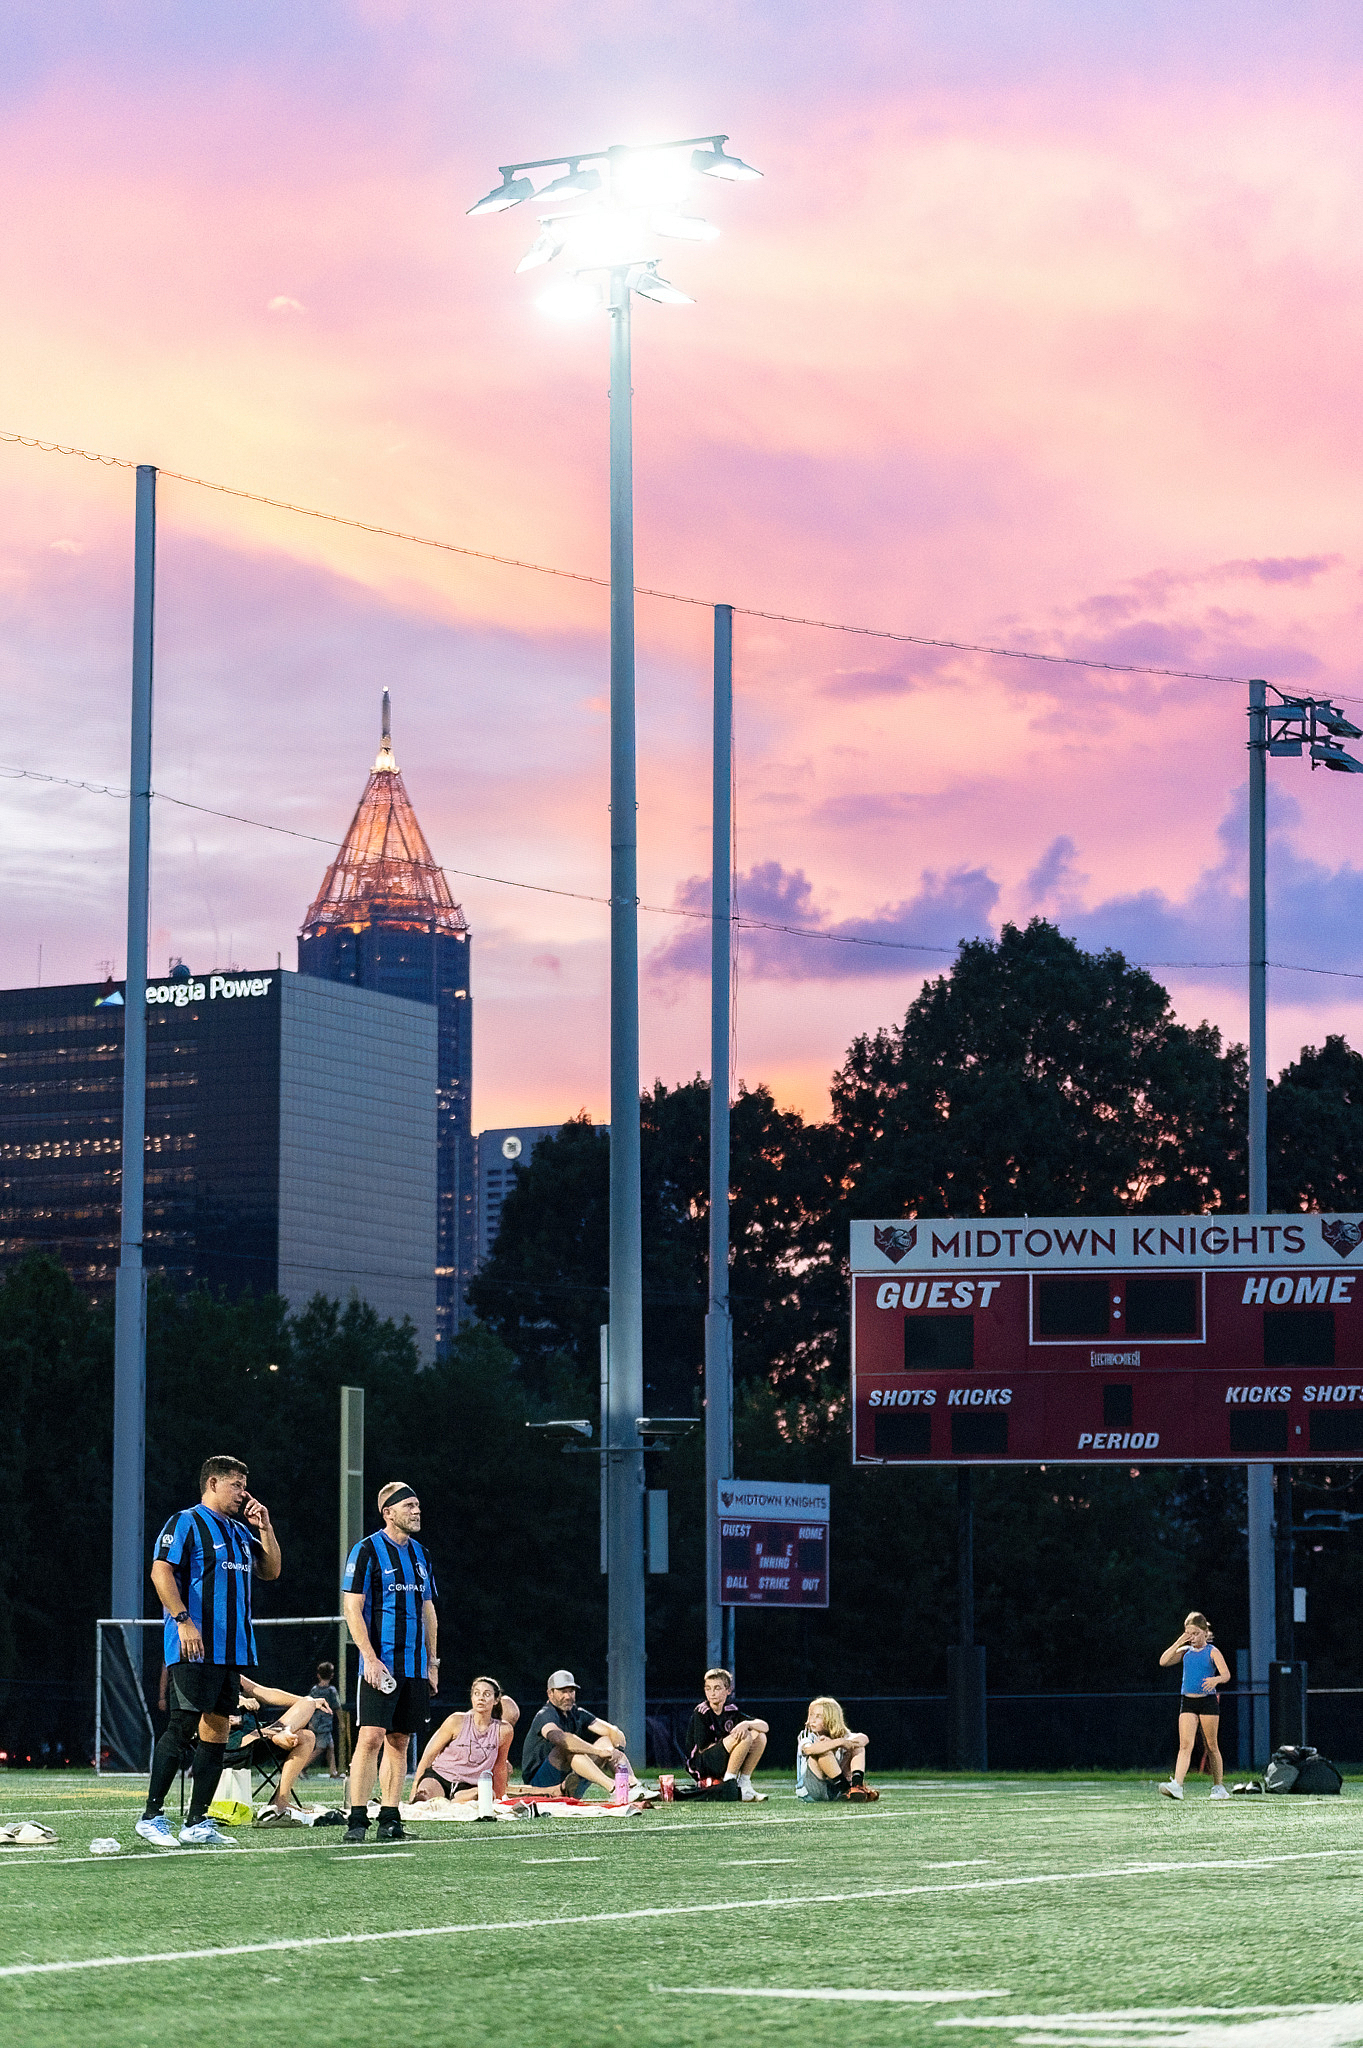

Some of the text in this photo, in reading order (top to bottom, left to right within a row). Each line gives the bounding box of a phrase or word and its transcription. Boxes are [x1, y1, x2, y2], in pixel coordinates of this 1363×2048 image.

[145, 976, 273, 1007] eorgia Power
[931, 1225, 1306, 1258] MIDTOWN KNIGHTS
[875, 1281, 1001, 1309] GUEST
[1241, 1276, 1356, 1305] HOME
[868, 1388, 1013, 1407] SHOTS KICKS
[1225, 1386, 1292, 1403] KICKS
[1078, 1432, 1160, 1450] PERIOD
[735, 1493, 827, 1509] MIDTOWN KNIGHTS
[722, 1523, 752, 1537] GUEST
[798, 1527, 825, 1540] HOME
[221, 1561, 251, 1572] COMPAS
[759, 1556, 790, 1570] INNING
[387, 1583, 426, 1593] COMPASS
[726, 1575, 749, 1589] BALL
[758, 1576, 791, 1590] STRIKE
[801, 1578, 820, 1591] OUT
